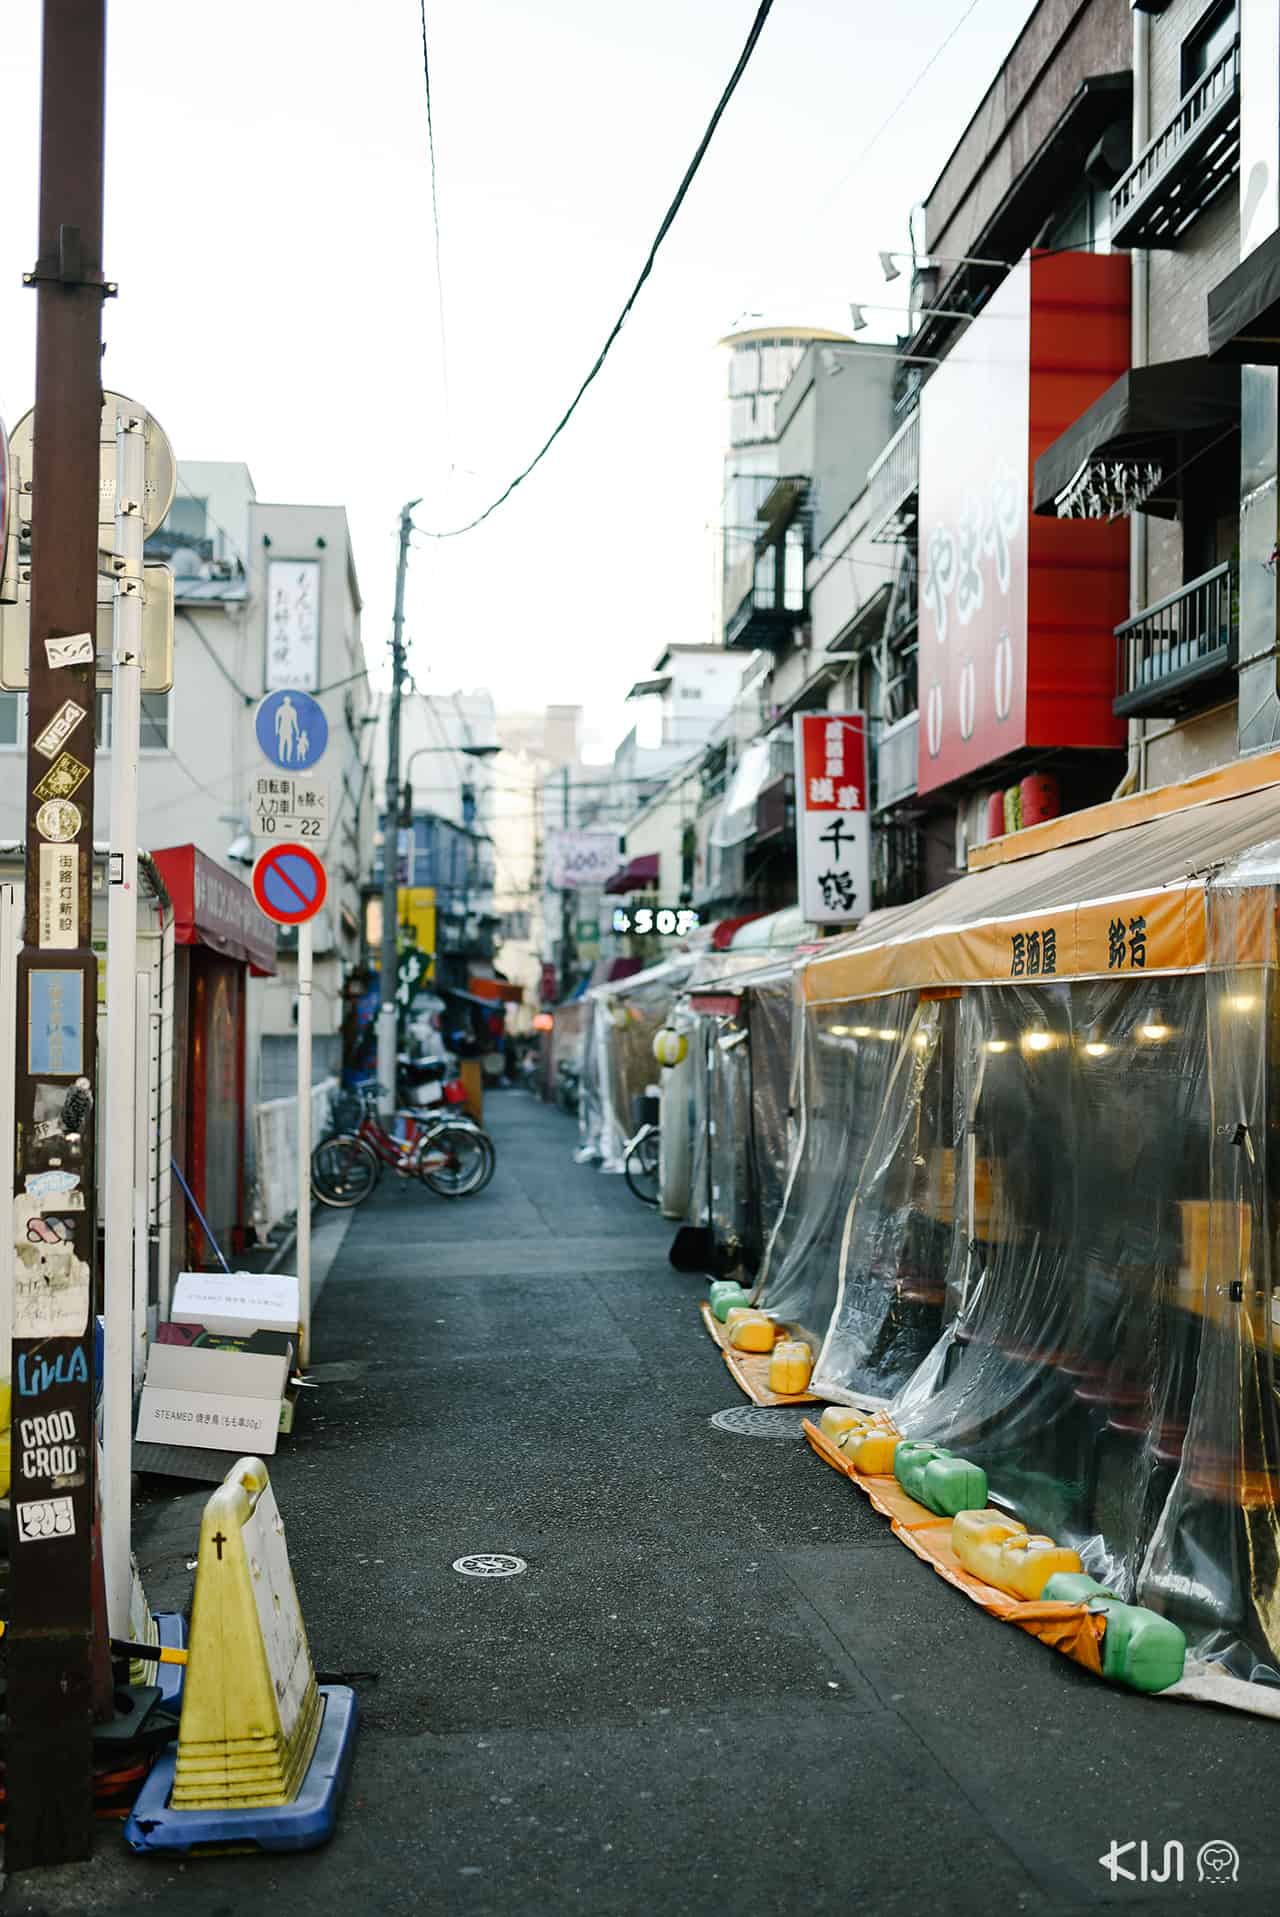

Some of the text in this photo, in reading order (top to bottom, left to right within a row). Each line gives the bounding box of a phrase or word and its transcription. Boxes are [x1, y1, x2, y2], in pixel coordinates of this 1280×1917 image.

[257, 779, 289, 794] 自転車
[256, 797, 289, 815] 人力車
[1011, 928, 1057, 976] 居酒屋
[154, 1408, 194, 1423] STEAMED
[20, 1410, 76, 1448] CROD
[23, 1445, 77, 1478] CROD
